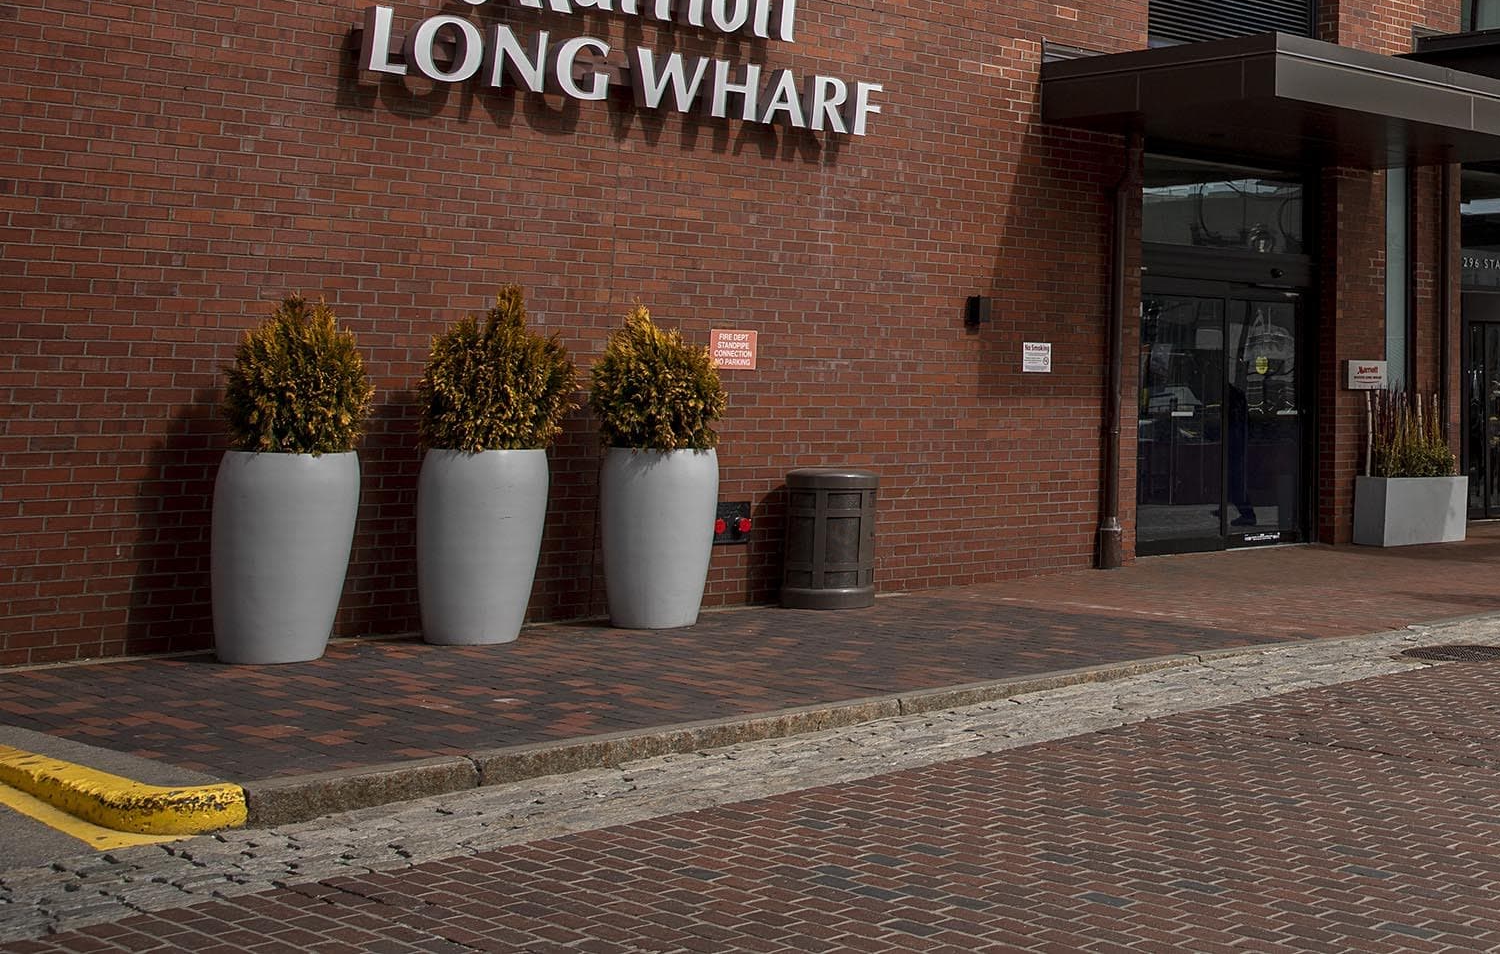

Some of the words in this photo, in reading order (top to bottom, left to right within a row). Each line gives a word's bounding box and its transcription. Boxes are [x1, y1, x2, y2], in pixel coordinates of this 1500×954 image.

[368, 6, 611, 101] LONG
[636, 46, 884, 136] WHARF
[1463, 257, 1480, 268] 296
[719, 333, 733, 341] FIRE
[733, 333, 750, 341] DEPT
[717, 341, 750, 350] STANDPIPE
[713, 349, 753, 358] CONNECTION
[724, 358, 751, 366] PARKING
